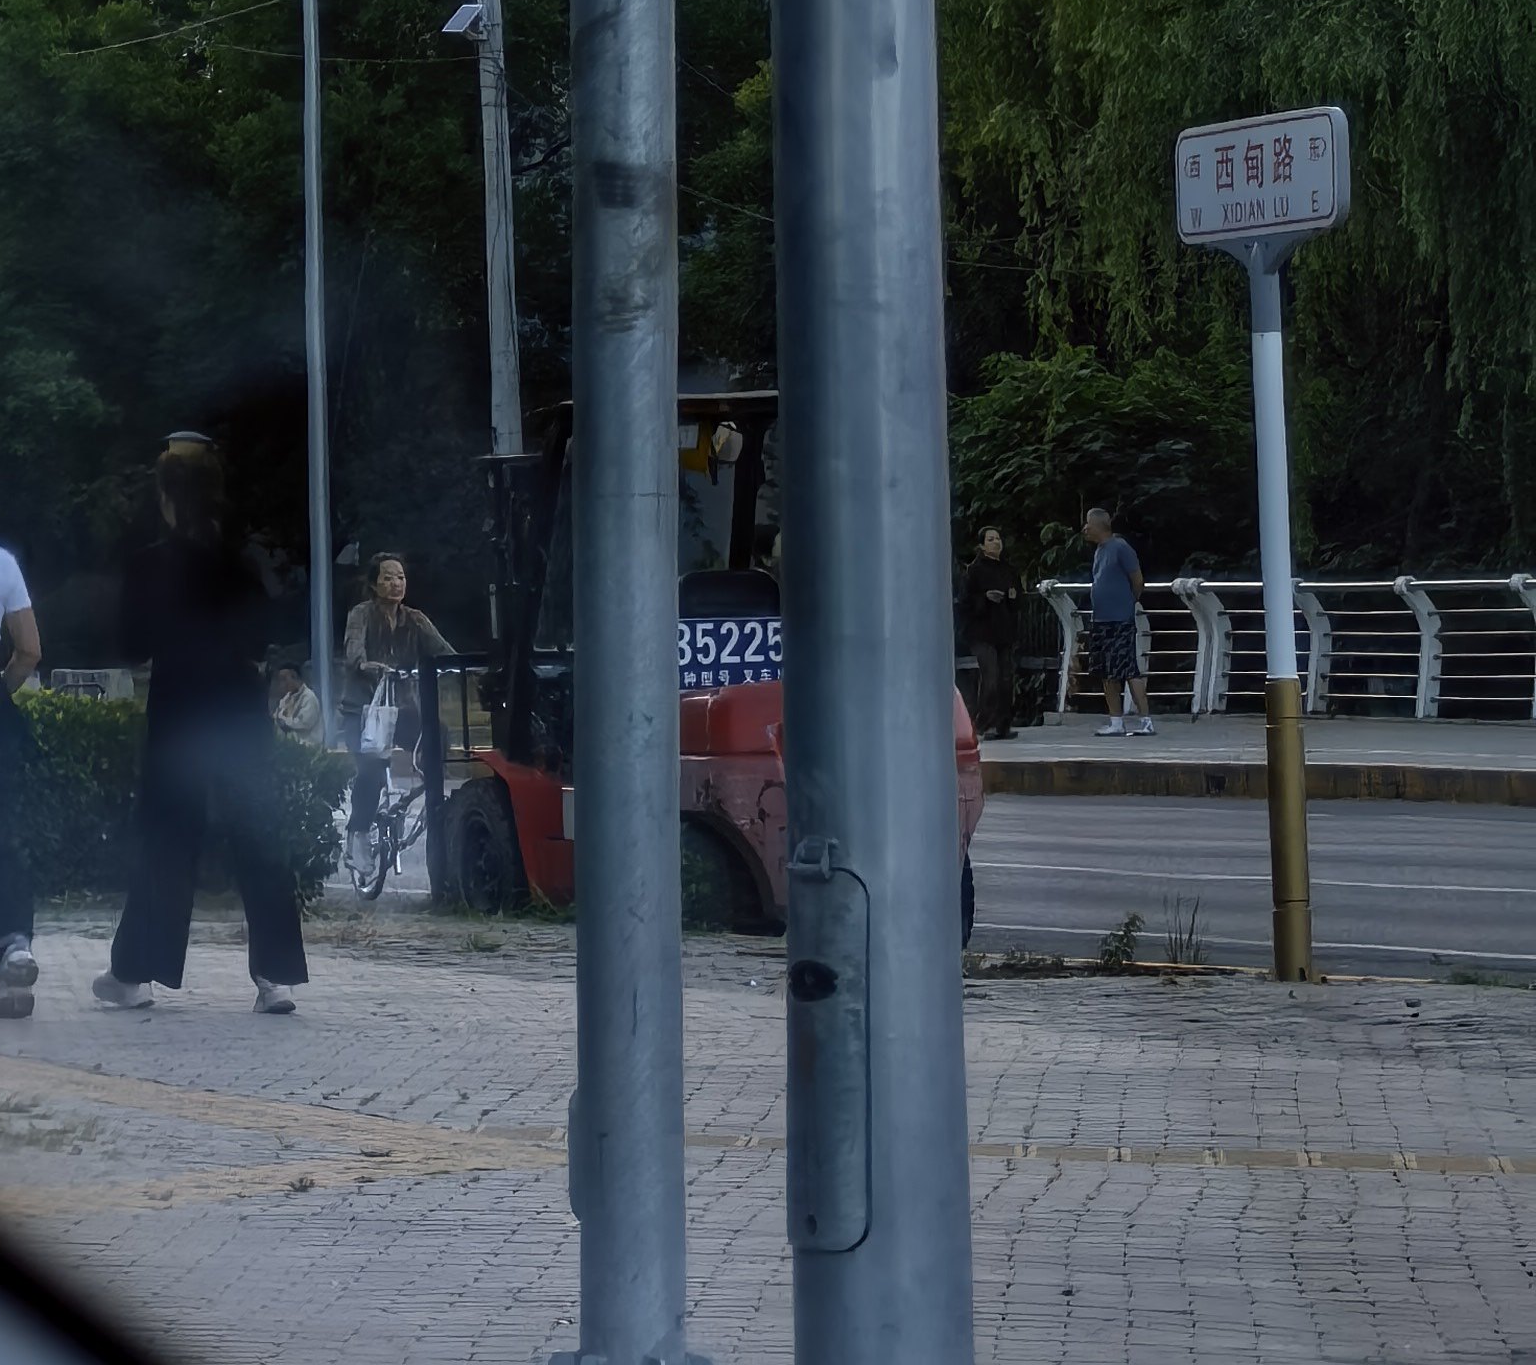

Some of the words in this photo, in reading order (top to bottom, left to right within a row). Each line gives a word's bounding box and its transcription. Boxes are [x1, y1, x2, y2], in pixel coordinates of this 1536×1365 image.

[1214, 133, 1295, 194] 西甸路
[1221, 197, 1265, 227] XIDIAN
[1273, 193, 1290, 219] LU
[1310, 190, 1321, 213] E
[743, 669, 781, 683] 叉车
